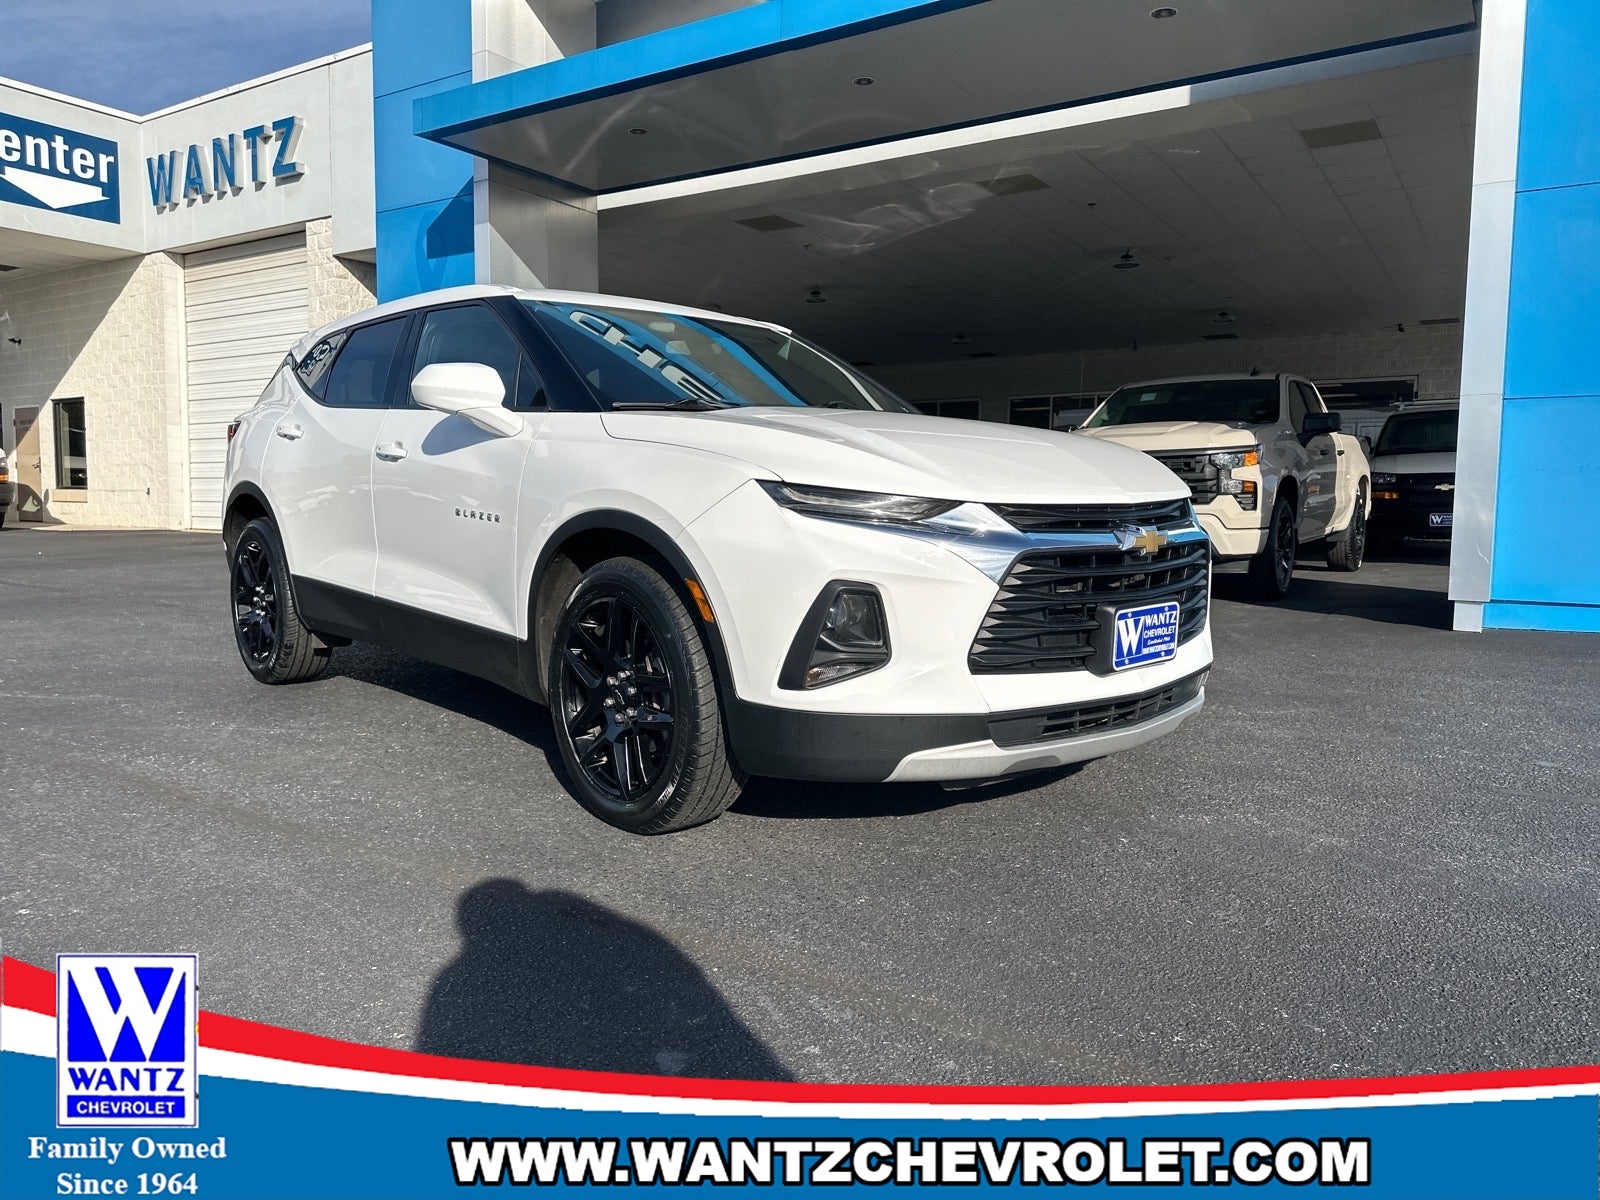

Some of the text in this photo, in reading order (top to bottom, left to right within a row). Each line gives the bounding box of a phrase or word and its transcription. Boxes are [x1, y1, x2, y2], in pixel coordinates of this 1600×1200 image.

[146, 116, 304, 215] WANTZ
[454, 507, 501, 523] BLAZER
[1144, 610, 1177, 627] WANTZ
[1117, 615, 1145, 658] W
[1143, 625, 1176, 639] CHEVROLET
